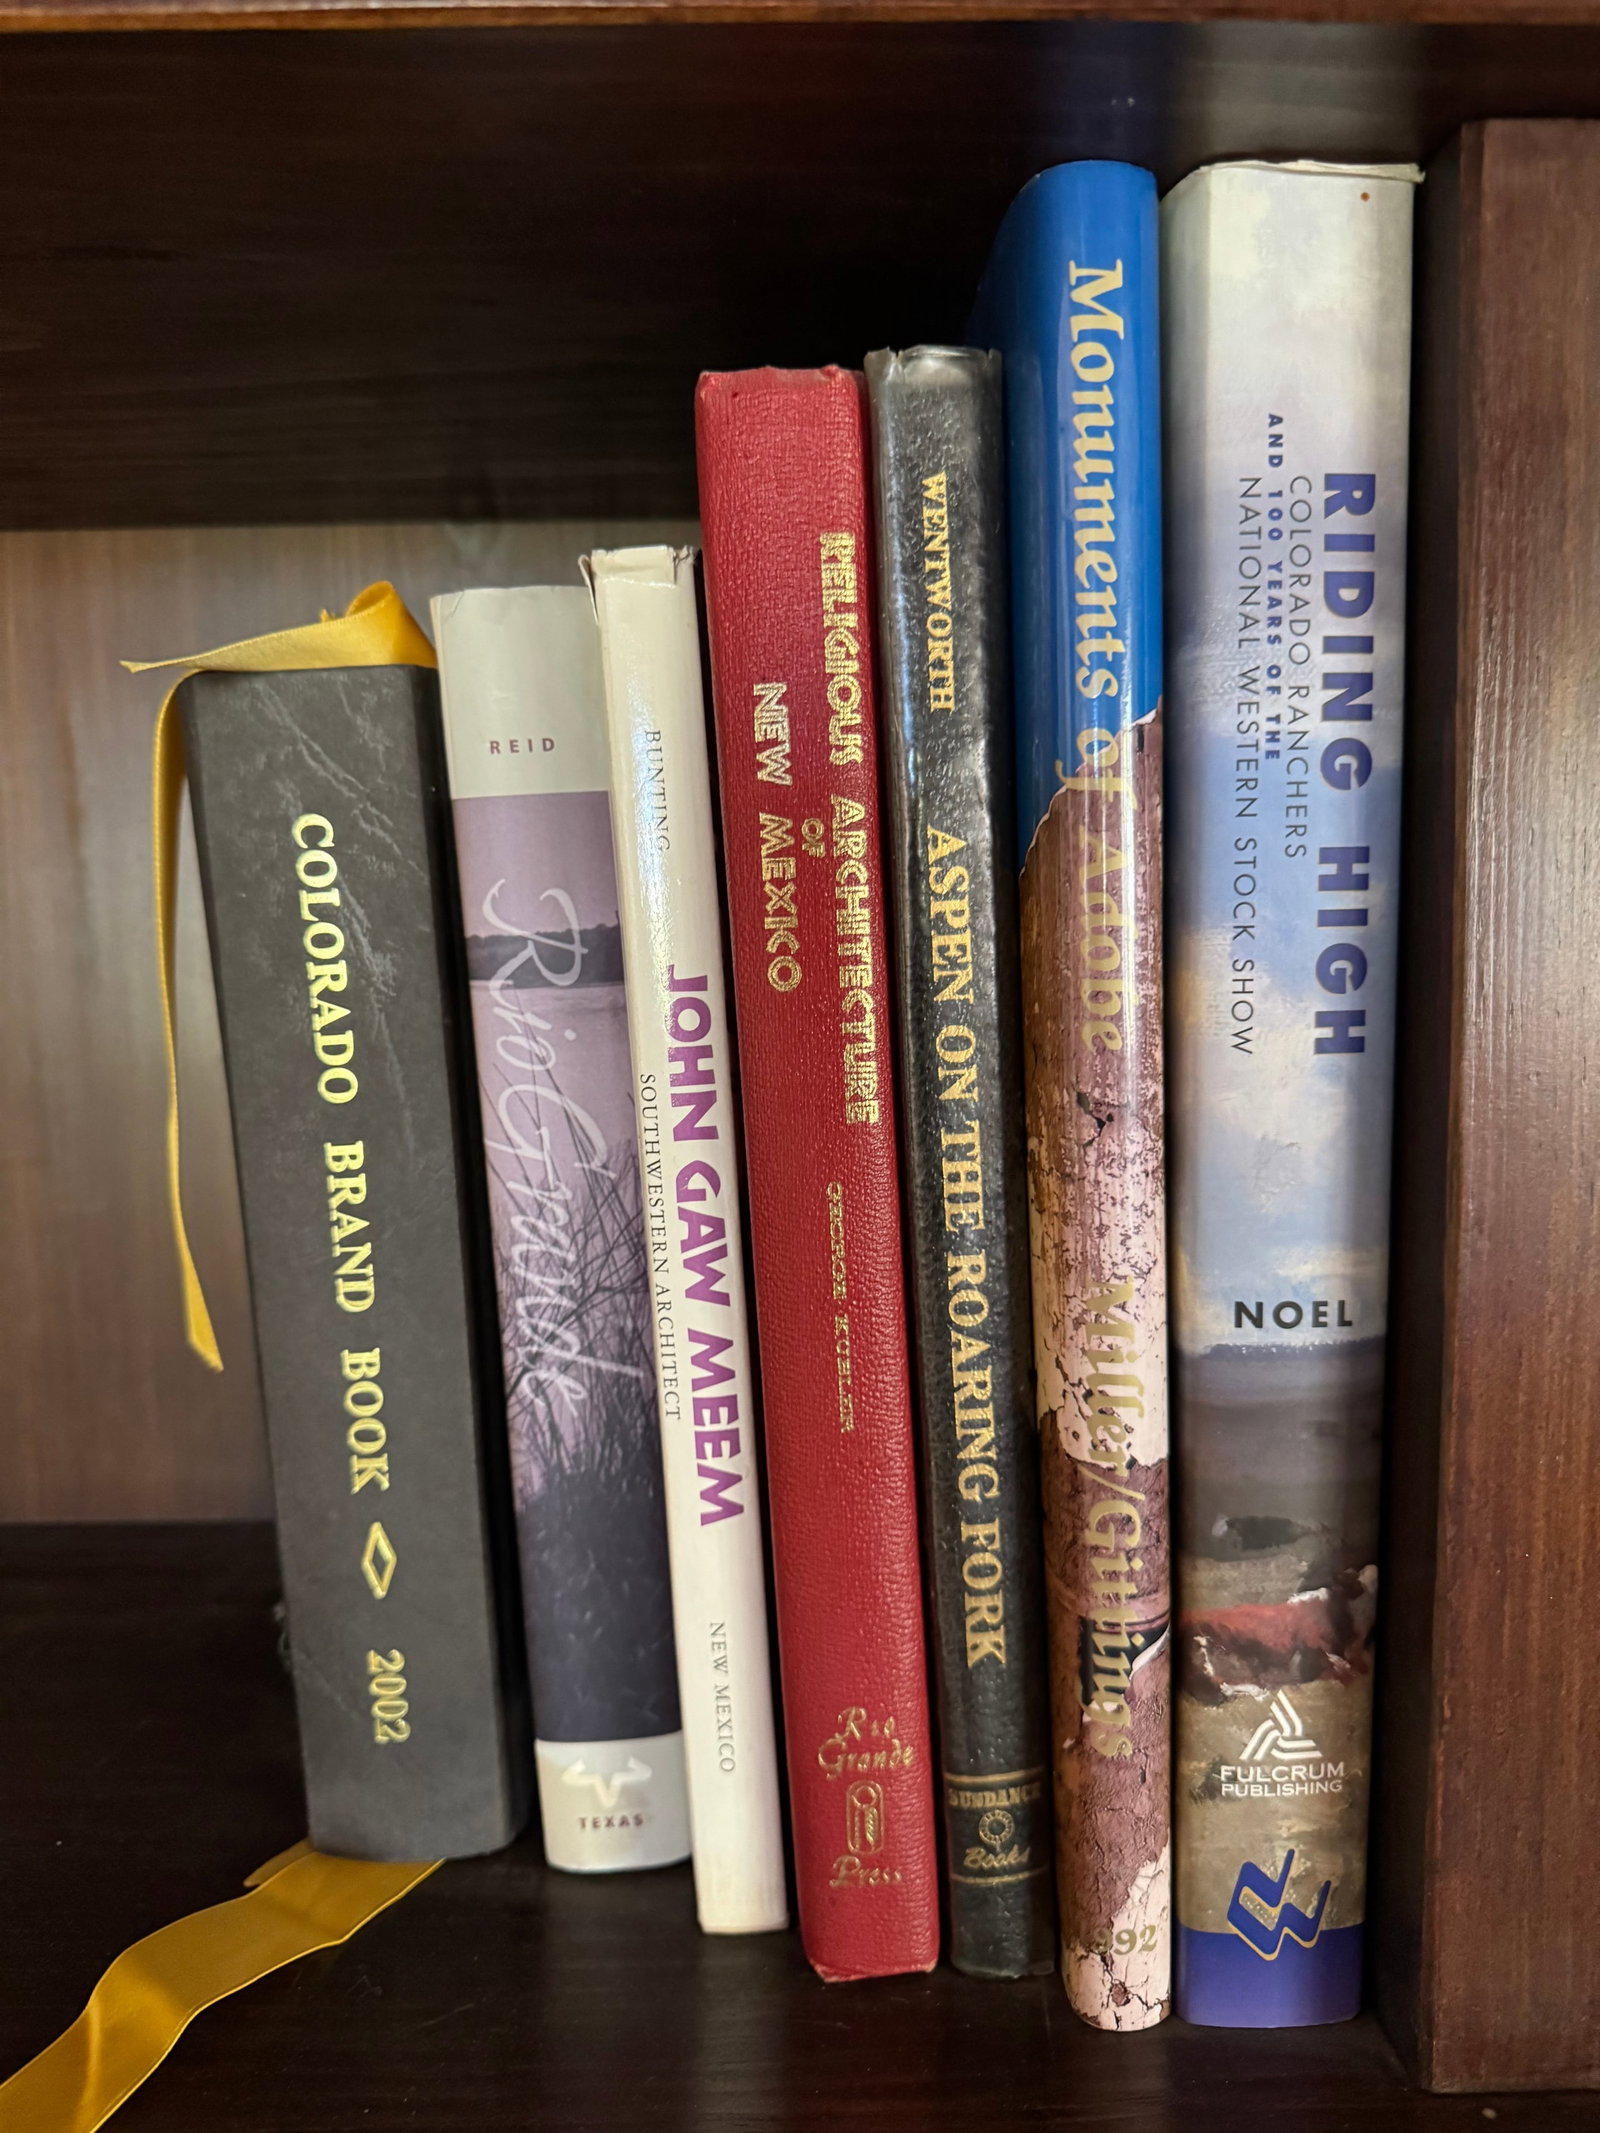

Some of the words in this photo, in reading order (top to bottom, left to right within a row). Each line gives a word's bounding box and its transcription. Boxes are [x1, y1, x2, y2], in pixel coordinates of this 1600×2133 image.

[1068, 258, 1127, 699] Monuments
[1267, 413, 1284, 468] AND
[1238, 477, 1262, 649] NATIONAL
[1267, 490, 1283, 541] 100
[1288, 475, 1312, 665] COLORADO
[819, 531, 865, 767] RELIGIOUS
[921, 471, 956, 714] WENTWORTH
[1266, 561, 1283, 645] YEARS
[1320, 473, 1376, 790] RIDING
[753, 681, 793, 787] NEW
[1264, 713, 1281, 760] THE
[1265, 664, 1282, 695] OF
[489, 737, 556, 755] REID
[644, 729, 671, 853] BUNTING
[1054, 727, 1138, 812] of
[1235, 666, 1260, 818] WESTERN
[1284, 686, 1310, 858] RANCHERS
[801, 817, 826, 858] OF
[1232, 837, 1257, 940] STOCK
[291, 812, 358, 1105] COLORADO
[759, 812, 802, 993] MEXICO
[830, 793, 880, 1125] ARCHITECTURE
[926, 826, 974, 1005] ASPEN
[1077, 823, 1140, 1053] Adobe
[1313, 846, 1370, 1055] HIGH
[482, 878, 589, 1072] Rio
[1230, 958, 1254, 1055] SHOW
[667, 963, 719, 1142] JOHN
[935, 1024, 980, 1102] ON
[323, 1140, 376, 1314] BRAND
[675, 1159, 731, 1307] GAW
[940, 1119, 985, 1233] THE
[484, 1083, 644, 1417] Grande
[640, 1074, 669, 1275] SOUTHWESTERN
[655, 1284, 681, 1420] ARCHITECT
[946, 1249, 1000, 1502] ROARING
[1233, 1300, 1353, 1330] NOEL
[340, 1348, 391, 1495] BOOK
[687, 1327, 745, 1527] MEEM
[709, 1621, 729, 1675] NEW
[960, 1517, 1007, 1669] FORK
[365, 1648, 411, 1745] 2002
[714, 1684, 736, 1773] MEXICO
[577, 1812, 645, 1830] TEXAS
[818, 1737, 914, 1781] Grande
[948, 1782, 1042, 1809] SUNDANCE
[1219, 1761, 1345, 1783] FULCRUM
[1220, 1778, 1343, 1797] PUBLISHING
[829, 1854, 904, 1888] Press
[963, 1844, 1031, 1870] Books
